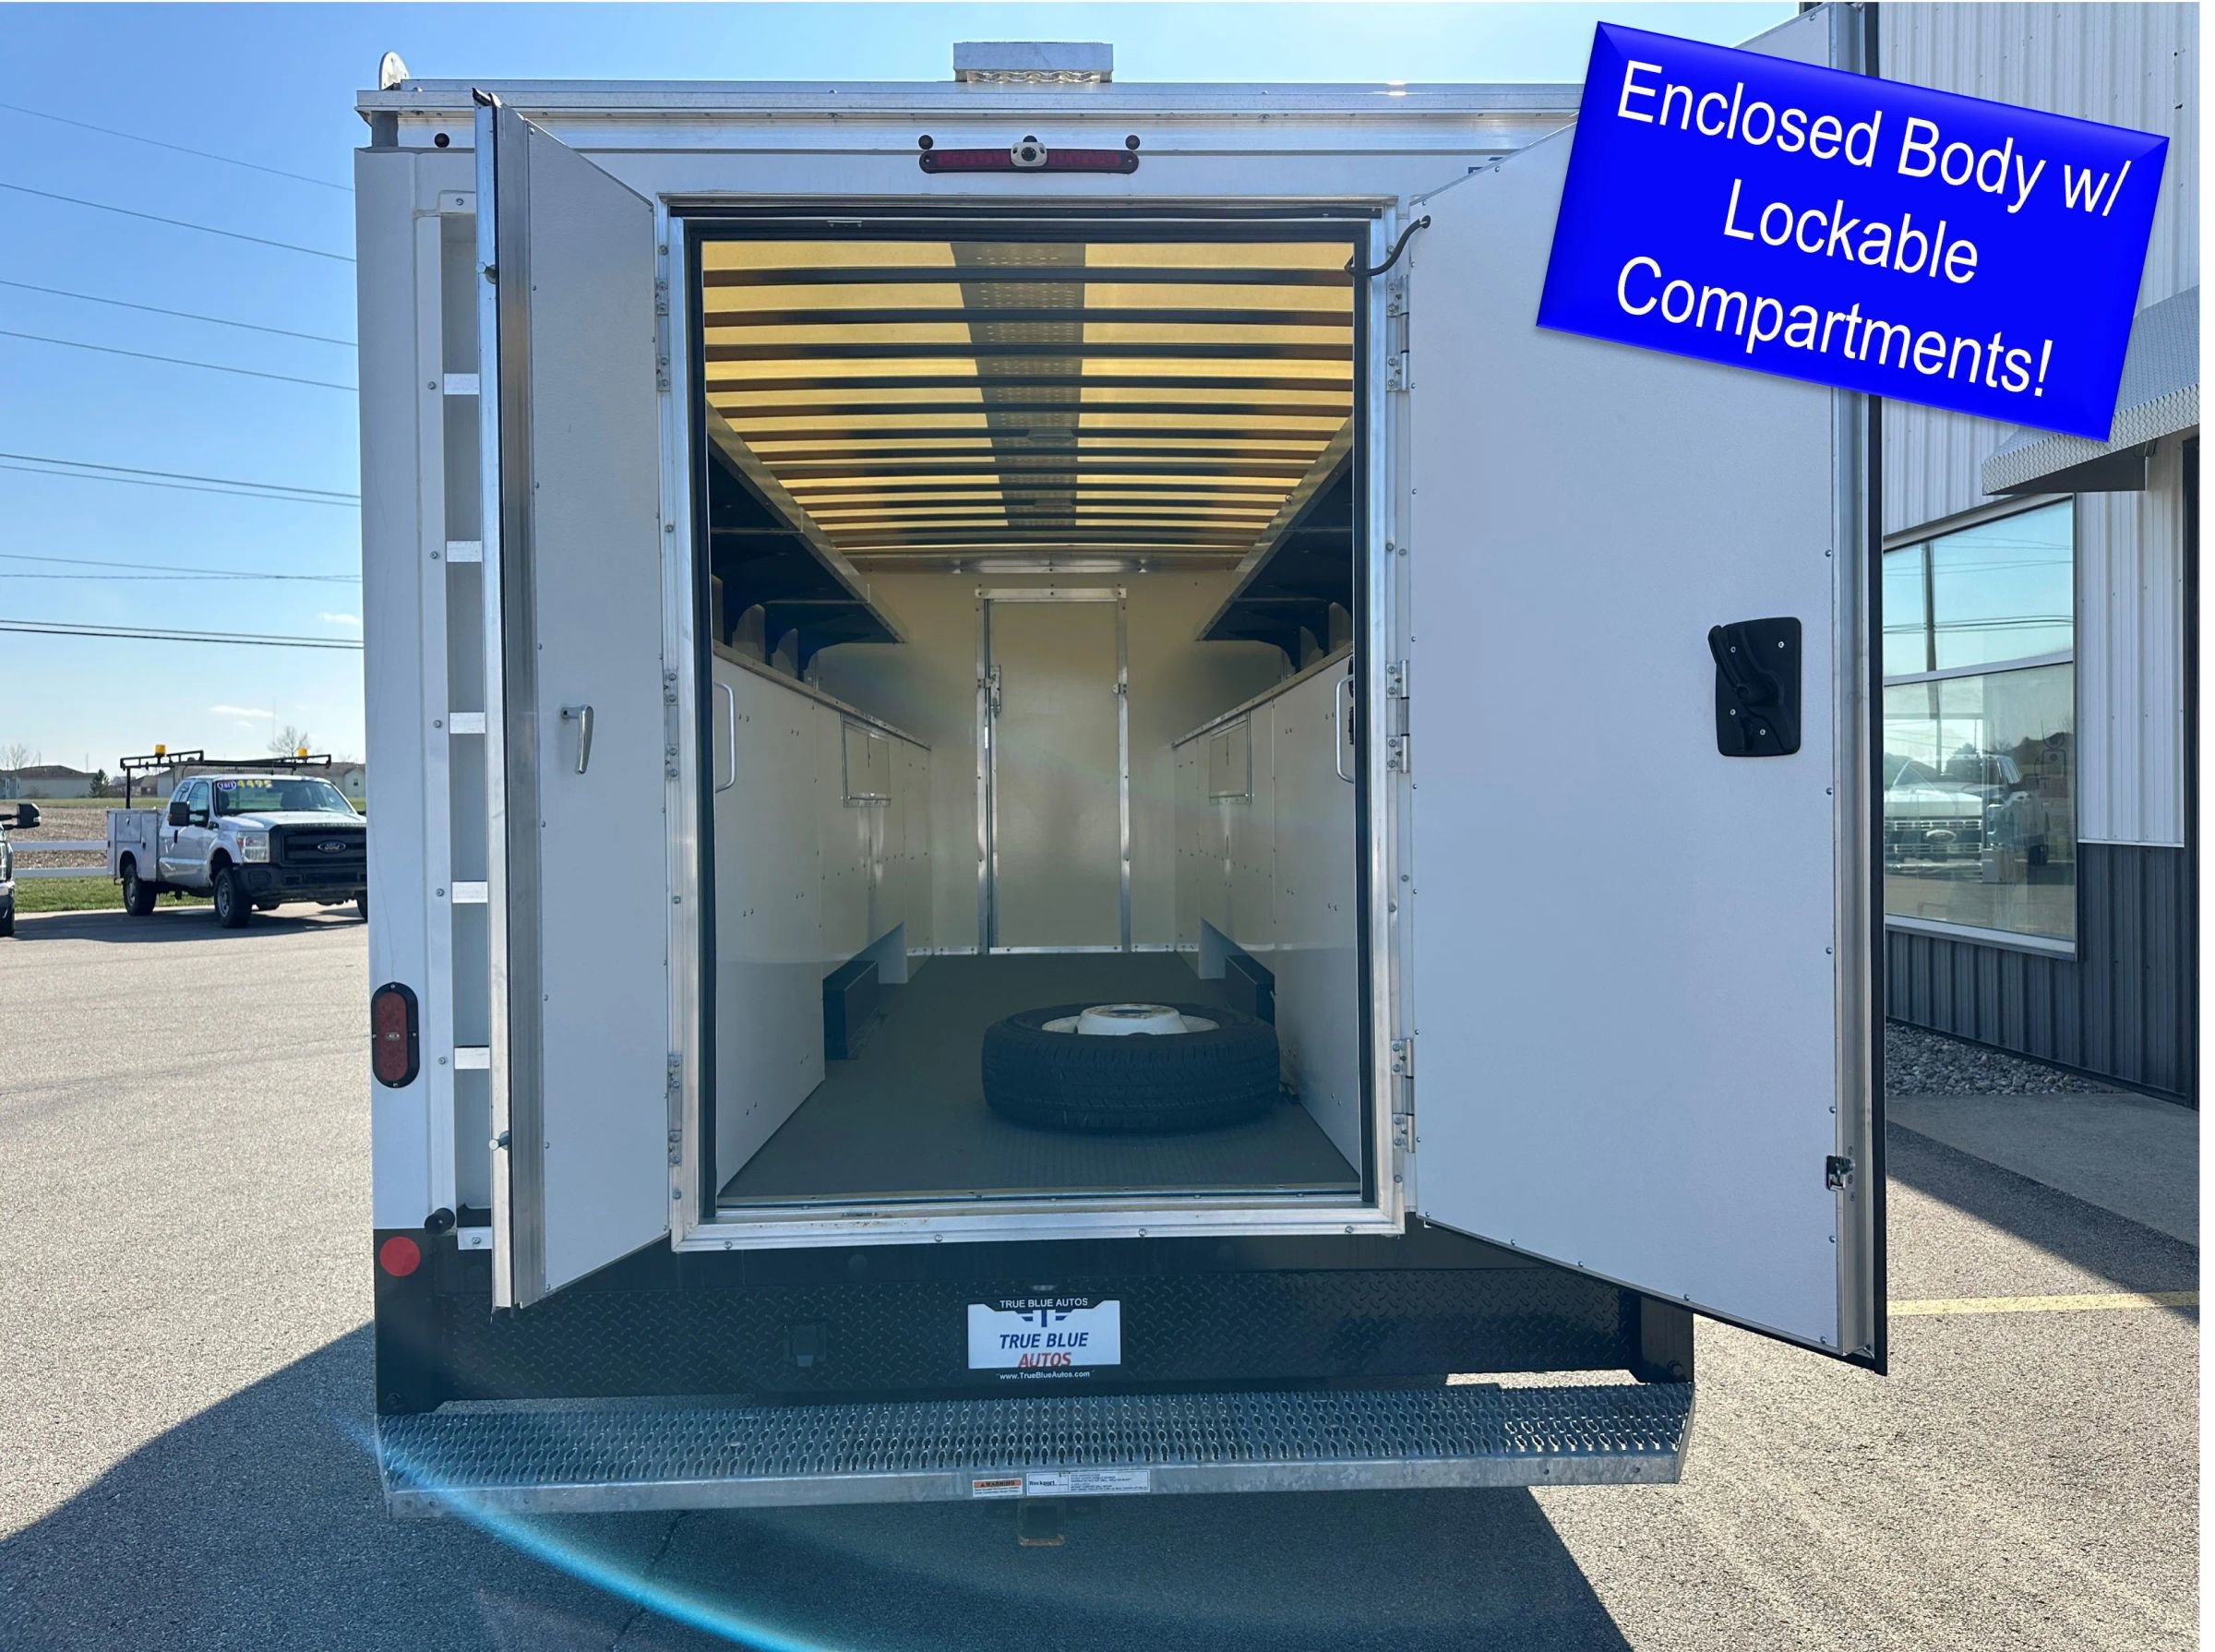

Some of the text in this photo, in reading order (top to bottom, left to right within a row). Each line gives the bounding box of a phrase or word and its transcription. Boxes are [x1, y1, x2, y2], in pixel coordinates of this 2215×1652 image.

[1000, 1298, 1088, 1309] TRUE BLUE AUTOS
[1000, 1332, 1089, 1349] TRUE BLUE
[1017, 1352, 1072, 1367] AUTOS
[1000, 1371, 1090, 1380] www.TrueBlueAutos.com
[986, 1479, 1015, 1488] WARNING
